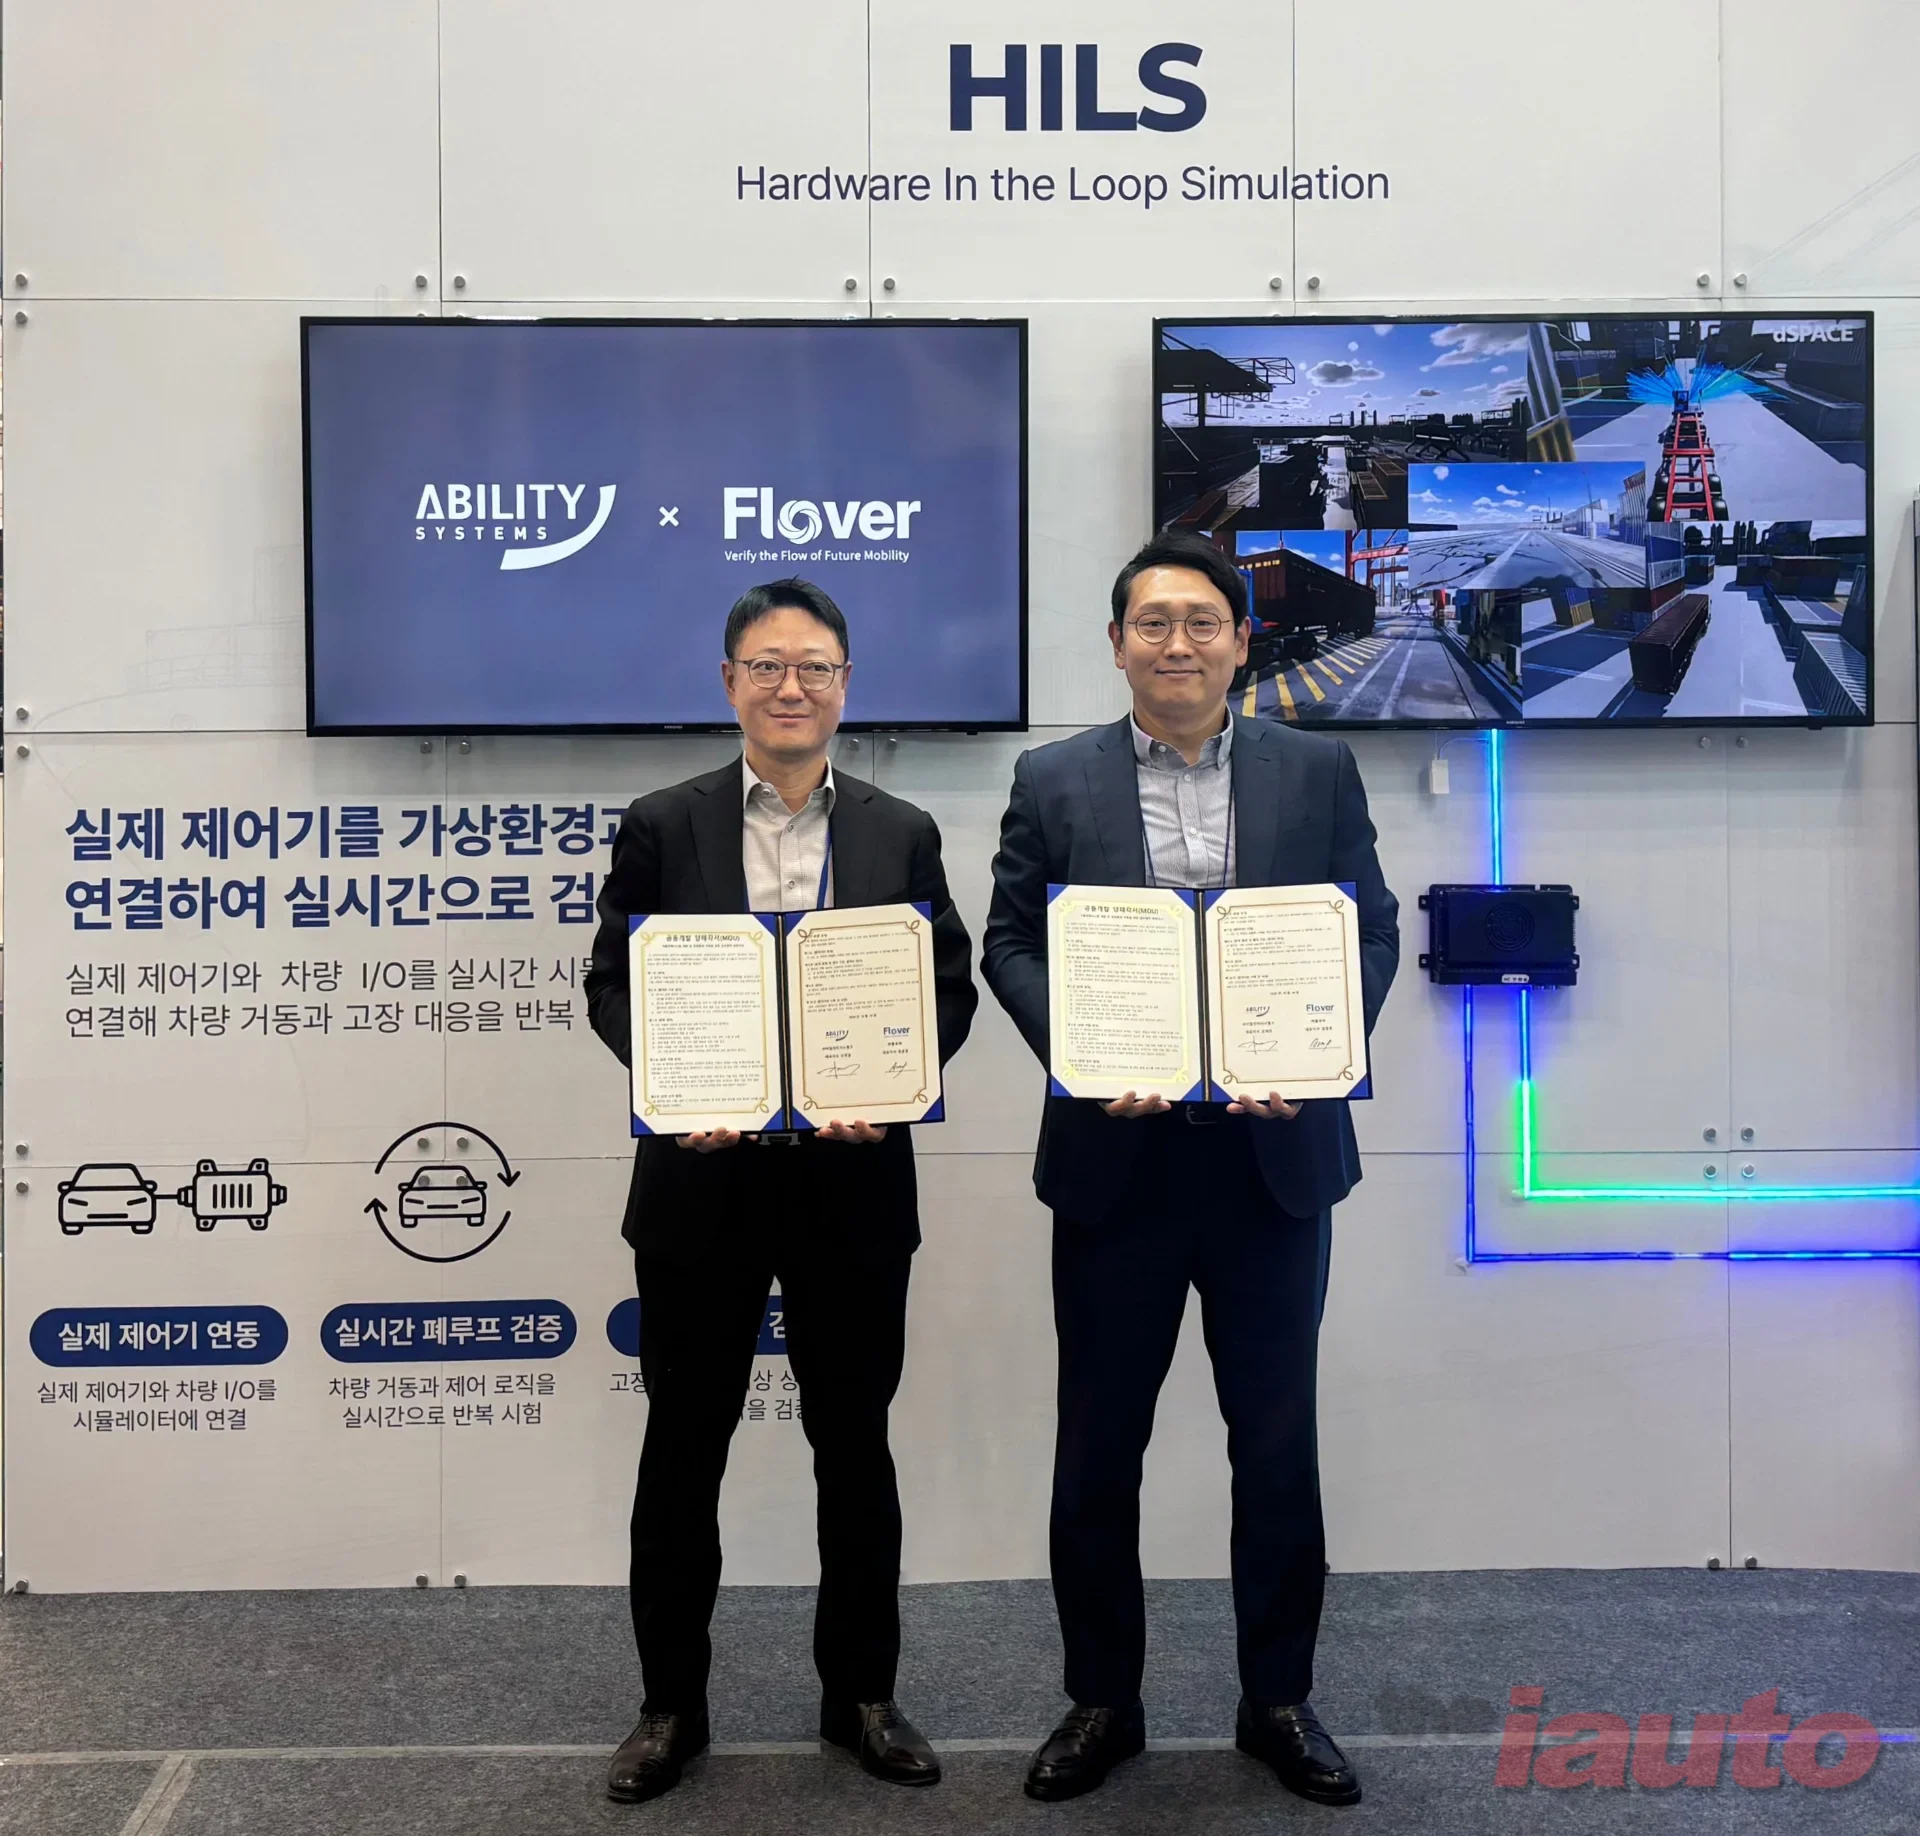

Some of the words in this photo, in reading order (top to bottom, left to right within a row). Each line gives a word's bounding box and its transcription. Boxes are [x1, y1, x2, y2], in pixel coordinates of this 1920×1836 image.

[949, 42, 1207, 133] HILS
[737, 166, 931, 201] Hardware
[945, 166, 977, 201] In
[990, 166, 1055, 201] the
[1070, 166, 1168, 210] Loop
[1181, 164, 1389, 201] Simulation
[1773, 325, 1854, 343] dSPACE
[415, 483, 586, 520] ABILITY
[723, 486, 922, 545] Flover
[415, 526, 548, 541] SYSTEMS
[724, 549, 757, 564] Verify
[759, 549, 779, 561] the
[780, 549, 808, 561] Flow
[810, 549, 823, 561] of
[824, 550, 862, 561] Future
[864, 549, 910, 563] Mobility
[65, 807, 164, 862] 실제
[180, 805, 384, 860] 제어기를
[65, 875, 266, 931] 연결하여
[283, 873, 535, 928] 실시간으로
[549, 871, 609, 924] 검
[66, 962, 125, 996] 실제
[137, 961, 262, 995] 제어기와
[281, 960, 343, 993] 차량
[362, 959, 438, 993] I/O를
[447, 957, 539, 990] 실시간
[549, 956, 594, 989] 시
[65, 1005, 156, 1038] 연결해
[168, 1004, 231, 1037] 차량
[240, 1002, 333, 1036] 거동과
[343, 1001, 405, 1034] 고장
[415, 1000, 505, 1033] 대응을
[515, 999, 575, 1031] 반복
[884, 1027, 910, 1035] Flover
[58, 1321, 110, 1351] 실제
[118, 1321, 197, 1351] 제어기
[206, 1320, 261, 1349] 연동
[335, 1317, 416, 1347] 실시간
[422, 1316, 502, 1346] 폐루프
[510, 1314, 563, 1343] 검증
[37, 1381, 78, 1404] 실제
[85, 1380, 170, 1404] 제어기와
[176, 1379, 218, 1403] 차량
[225, 1379, 277, 1403] I/O를
[329, 1377, 371, 1400] 차량
[377, 1375, 440, 1399] 거동과
[445, 1374, 486, 1398] 제어
[493, 1373, 556, 1396] 로직을
[73, 1409, 198, 1433] 시뮬레이터에
[205, 1408, 246, 1431] 연결
[342, 1405, 446, 1429] 실시간으로
[453, 1403, 494, 1426] 반복
[501, 1401, 541, 1425] 시험
